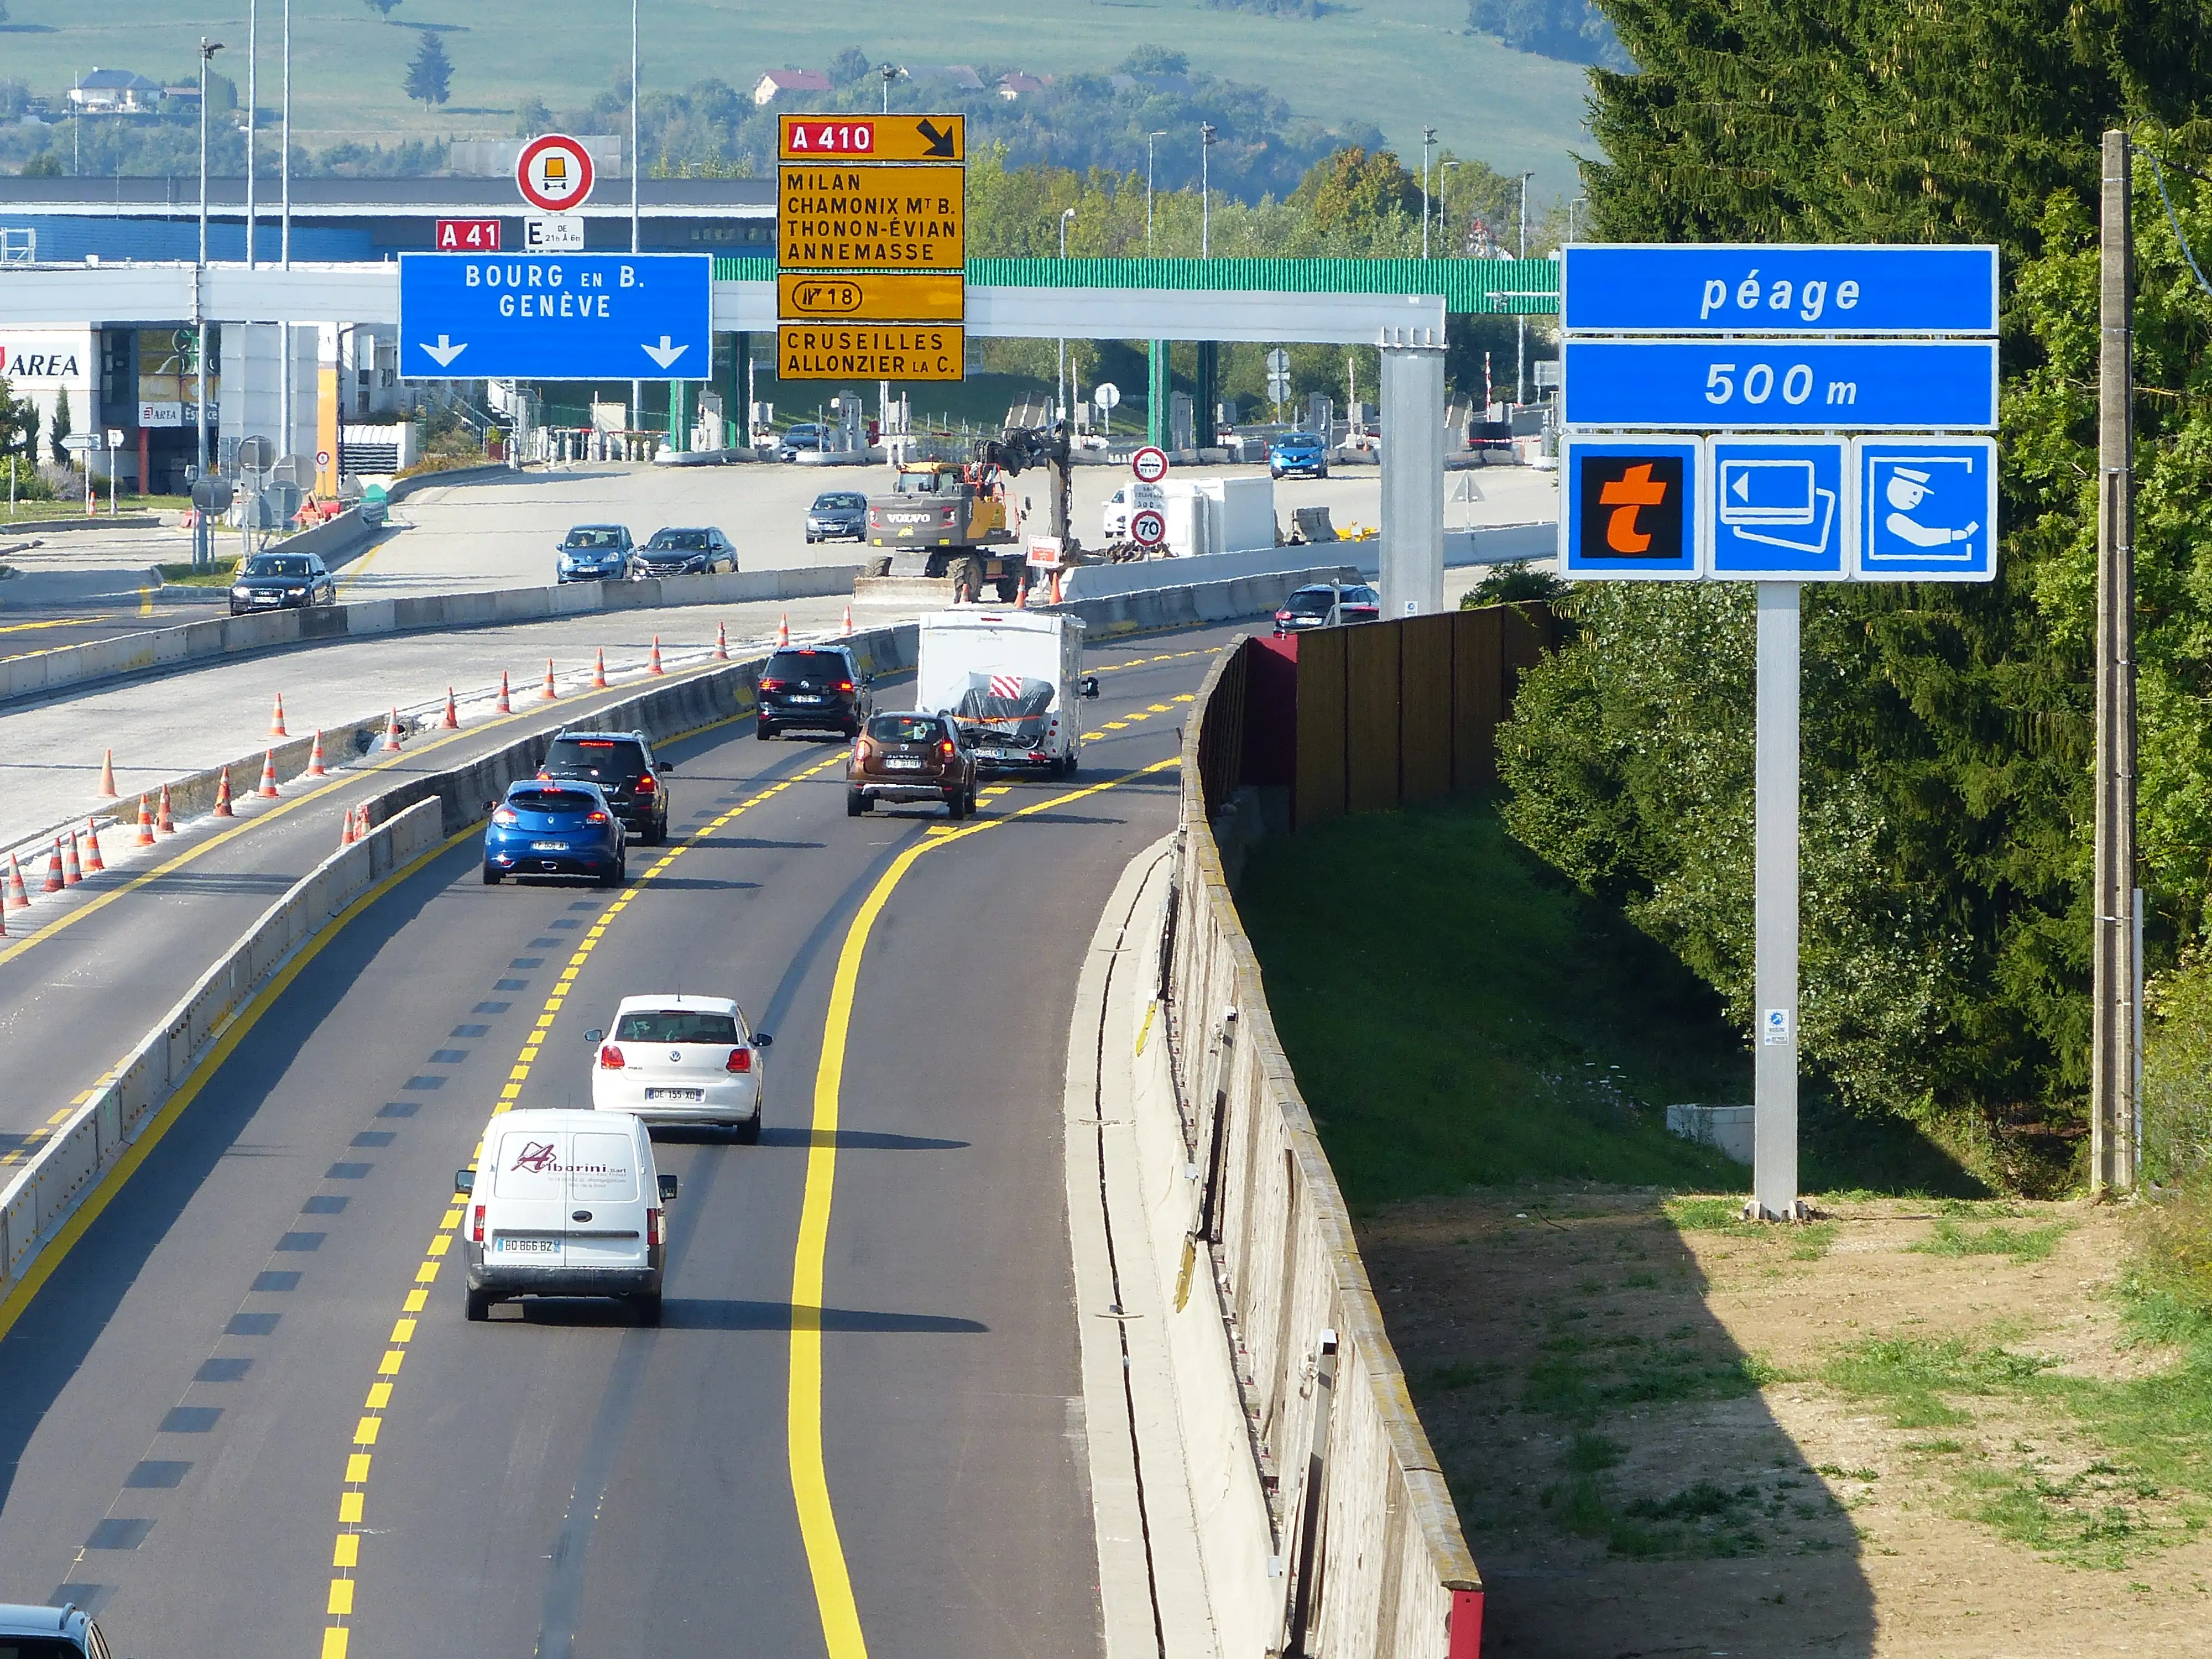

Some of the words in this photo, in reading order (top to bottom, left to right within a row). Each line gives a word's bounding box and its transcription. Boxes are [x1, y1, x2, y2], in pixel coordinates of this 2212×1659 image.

[792, 126, 807, 149] A
[818, 126, 869, 149] 410
[787, 174, 859, 191] MILAN
[787, 197, 898, 215] CHAMONIX
[938, 198, 955, 215] B.
[441, 224, 457, 247] A
[466, 224, 495, 246] 41
[529, 222, 542, 245] E
[787, 217, 956, 238] THONON-ÉVIAN
[787, 243, 933, 260] ANNEMASSE
[466, 265, 563, 287] BOURG
[581, 273, 602, 287] EN
[620, 265, 644, 288] B.
[499, 291, 610, 317] GENÈVE
[828, 288, 853, 305] 18
[1700, 269, 1860, 321] péage
[787, 332, 942, 350] CRUSEILLES
[8, 354, 79, 376] AREA
[787, 355, 904, 373] ALLONZIER
[912, 362, 928, 373] LA
[937, 356, 955, 373] C.
[1705, 364, 1813, 405] 500
[1827, 382, 1857, 404] m
[154, 410, 176, 419] AREA
[185, 407, 217, 424] Espce
[886, 513, 931, 523] VOLVO
[1139, 521, 1160, 536] 70
